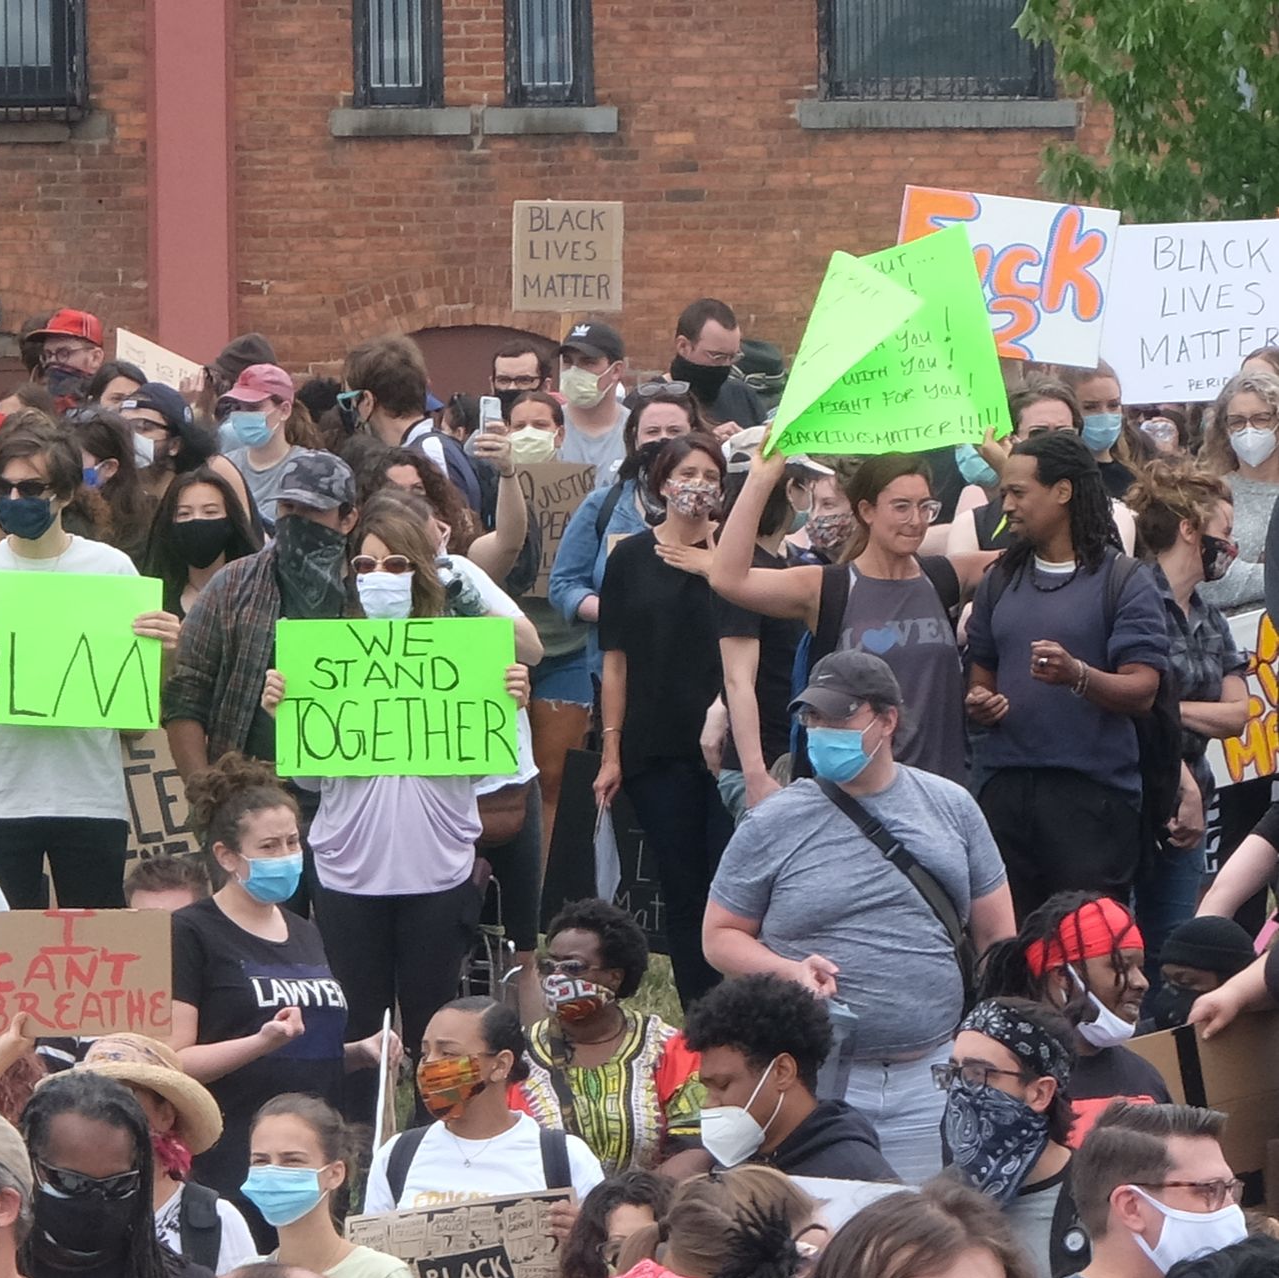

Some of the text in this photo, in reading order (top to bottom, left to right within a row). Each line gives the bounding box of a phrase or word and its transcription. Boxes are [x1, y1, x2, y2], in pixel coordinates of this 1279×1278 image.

[528, 206, 606, 232] BLACK
[529, 240, 597, 261] LIVES
[1154, 236, 1272, 274] BLACK
[523, 273, 610, 299] MATTER
[1161, 282, 1265, 318] LIVES
[819, 397, 872, 415] FIGHT
[883, 388, 914, 407] FOR
[1188, 377, 1227, 391] PERI
[347, 621, 433, 657] WE
[310, 656, 459, 691] STAND
[283, 698, 518, 768] TOGETHER
[39, 911, 98, 955] I
